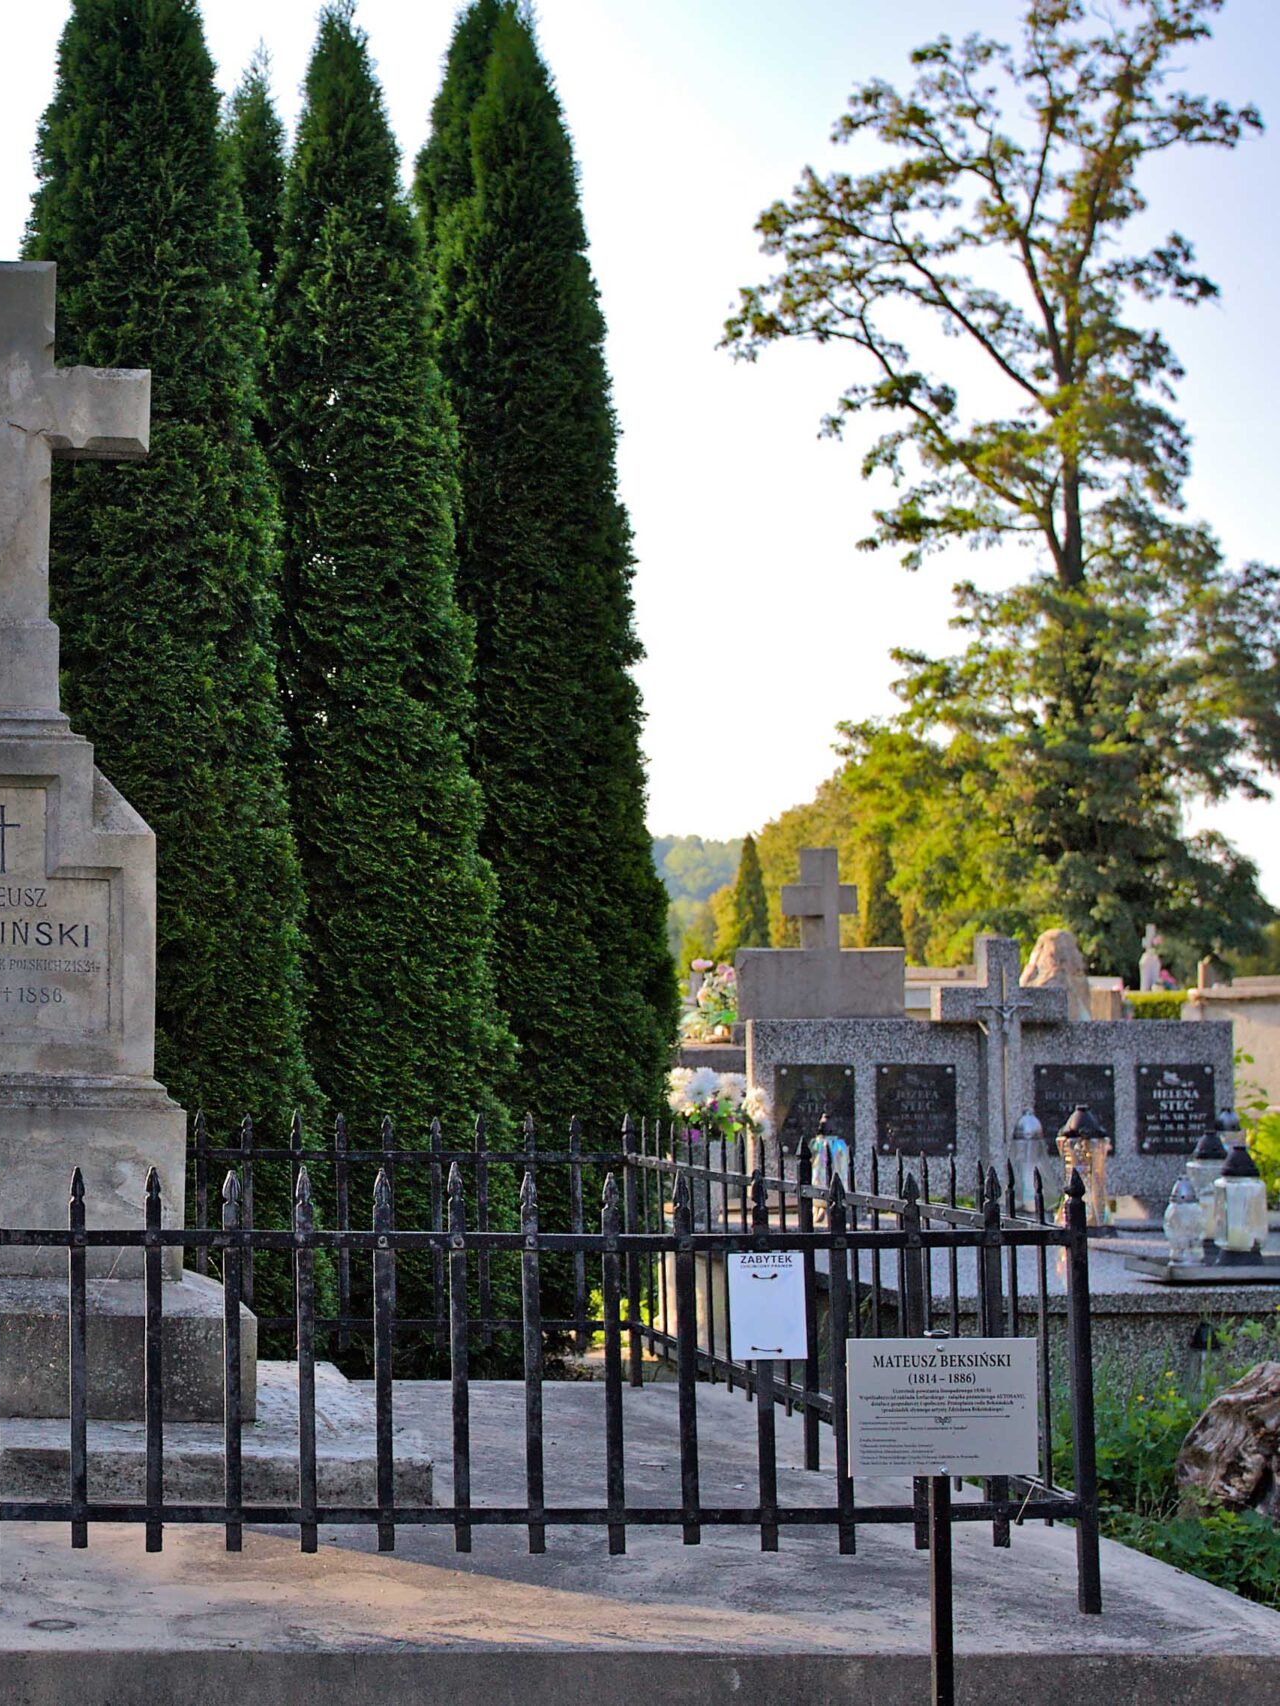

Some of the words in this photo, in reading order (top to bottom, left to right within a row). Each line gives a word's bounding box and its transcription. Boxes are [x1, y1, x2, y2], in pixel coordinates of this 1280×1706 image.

[9, 958, 62, 972] POLSKICH
[1152, 1089, 1200, 1099] HELENA
[1159, 1100, 1195, 1111] STEC
[740, 1255, 792, 1264] ZABYTEK
[873, 1354, 936, 1368] MATEUSZ
[940, 1352, 1011, 1368] BEKSIŃSKI
[908, 1373, 937, 1385] (1814
[948, 1373, 976, 1385] 1886)
